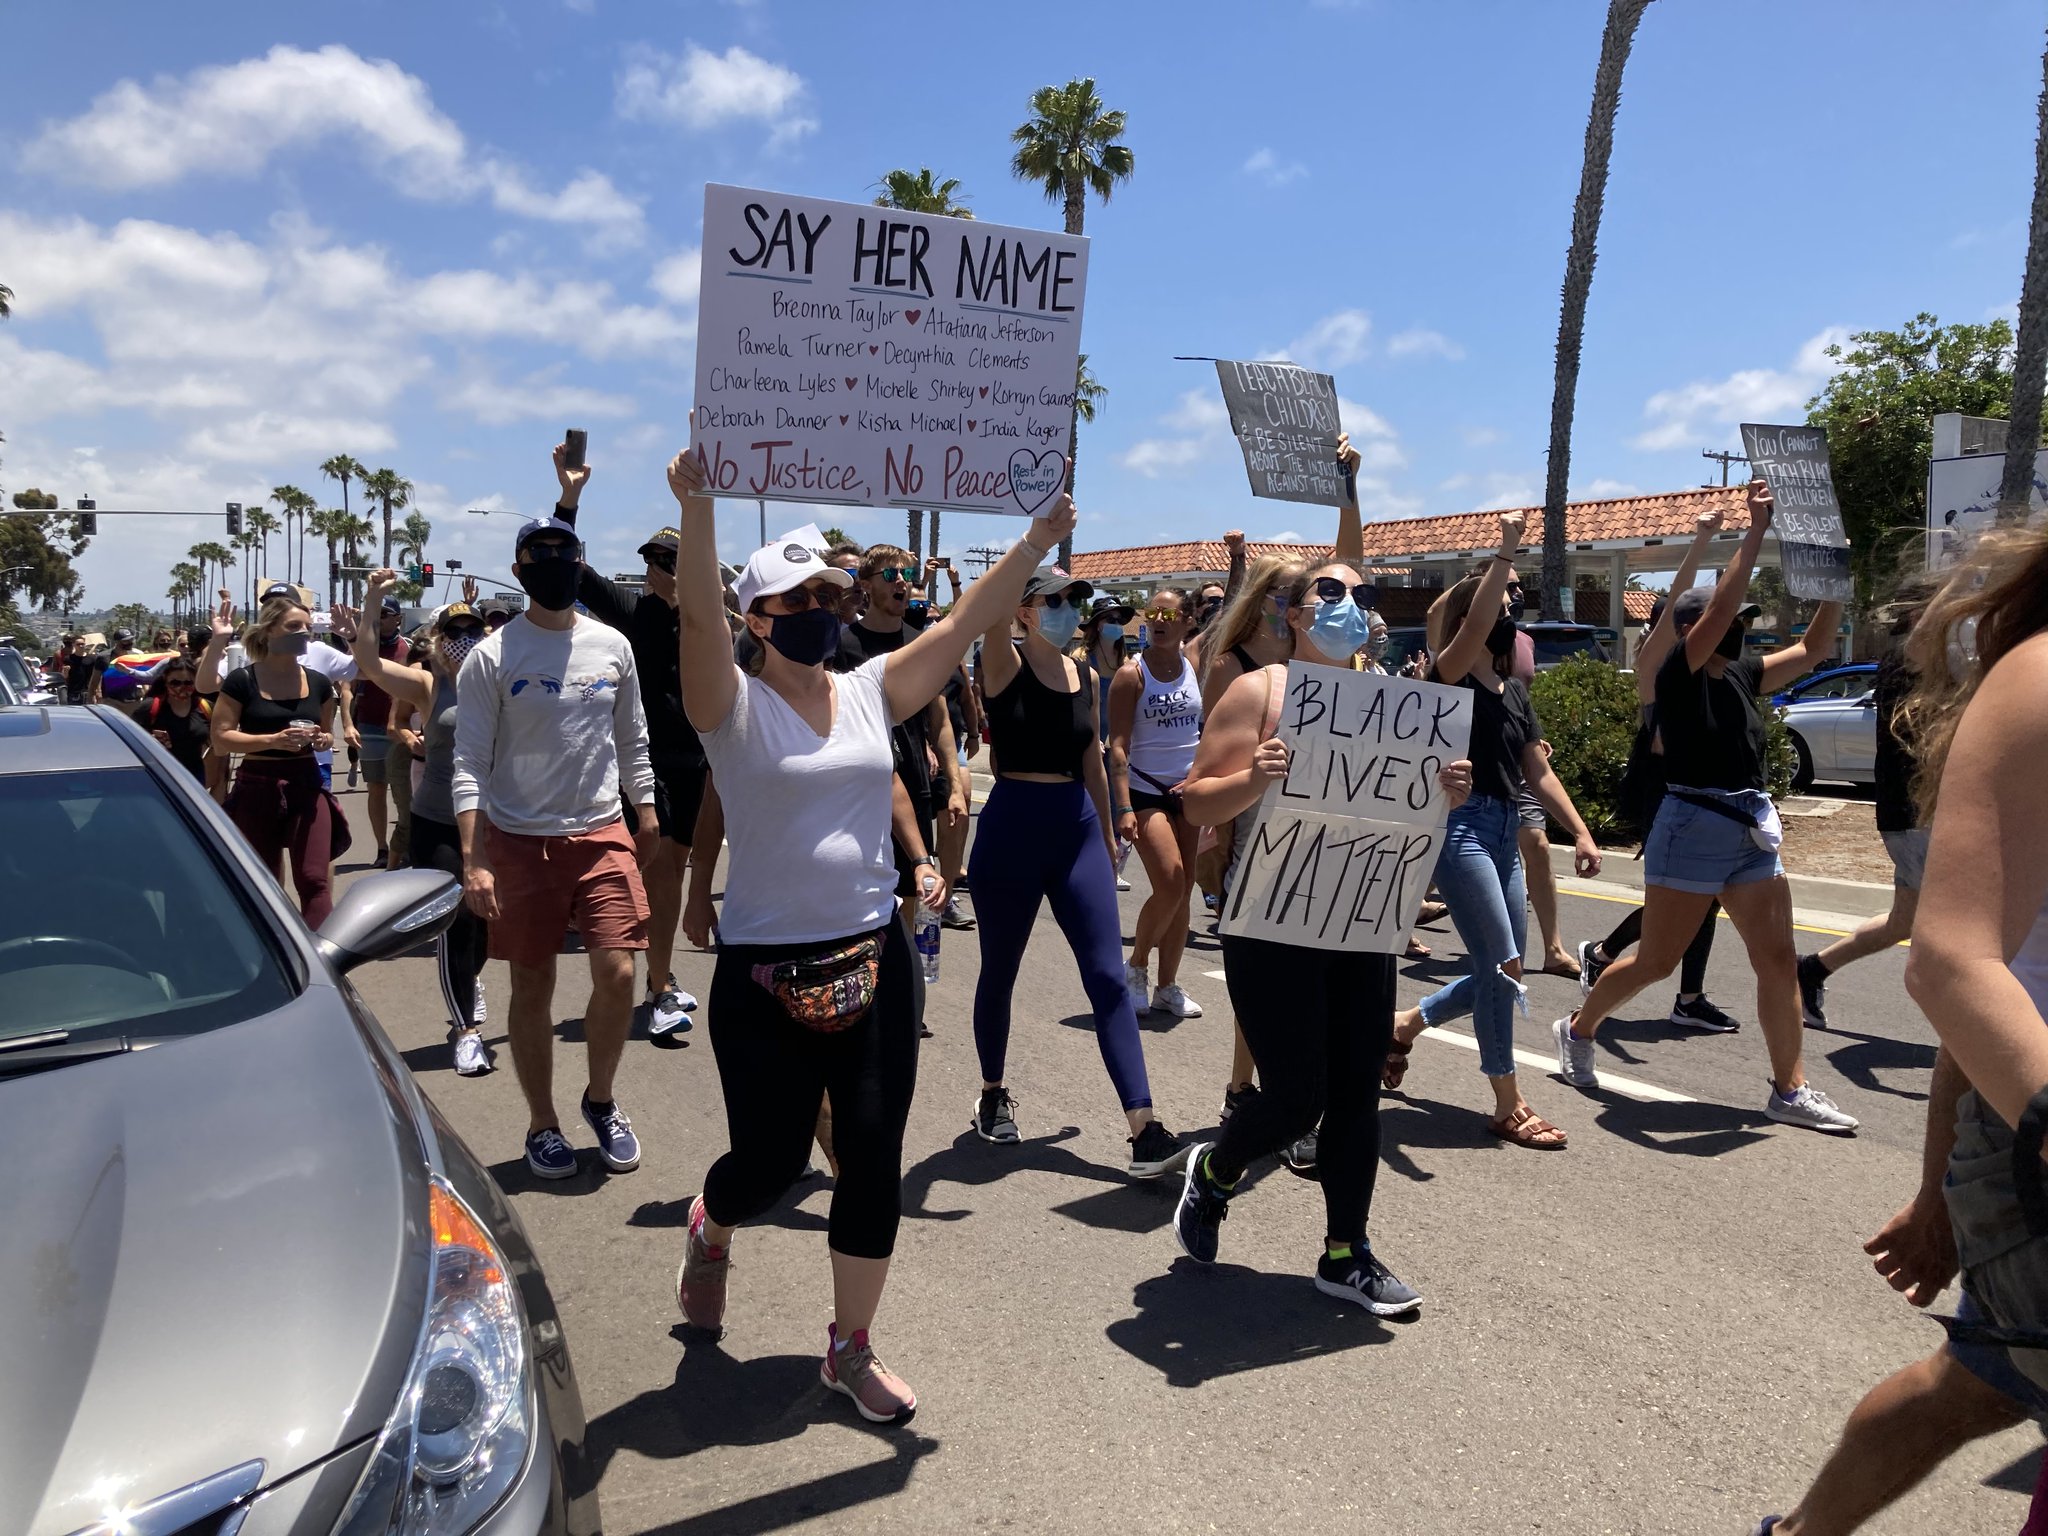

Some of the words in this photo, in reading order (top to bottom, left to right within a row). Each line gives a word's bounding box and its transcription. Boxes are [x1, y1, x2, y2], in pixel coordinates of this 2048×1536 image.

[728, 203, 832, 275] SAY
[853, 217, 934, 297] HER
[955, 235, 1077, 312] NAME
[773, 290, 843, 320] Breonna
[845, 299, 900, 333] Taylor
[923, 306, 988, 342] Atatiana
[991, 314, 1055, 343] Jefferson
[738, 326, 795, 357] Pamela
[801, 333, 868, 357] Turner
[884, 340, 956, 374] Decynthia
[969, 347, 1030, 370] Clements
[710, 367, 792, 393] Charleena
[798, 373, 837, 400] Lyles
[866, 374, 920, 399] Michelle
[928, 378, 976, 409] Shirley
[992, 380, 1035, 416] Korryn
[1039, 385, 1076, 408] Gaines
[1232, 361, 1290, 393] TEACH
[1286, 367, 1336, 401] BLACK
[699, 405, 764, 430] Deborah
[776, 407, 833, 430] Danner
[858, 410, 902, 432] Kisha
[911, 412, 962, 435] Michael
[979, 418, 1020, 438] India
[1026, 416, 1066, 445] Kager
[1264, 392, 1338, 432] CHILDREN
[1255, 428, 1276, 451] BE
[1277, 432, 1324, 454] SILENT
[1746, 426, 1777, 458] YOU
[1780, 429, 1819, 456] CANNOT
[698, 440, 739, 490] No
[750, 440, 872, 498] Justice,
[884, 444, 923, 495] No
[944, 445, 1012, 499] Peace
[1013, 462, 1037, 478] Rest
[1043, 465, 1055, 478] in
[1249, 449, 1280, 472] ABOUT
[1284, 453, 1304, 472] THE
[1308, 458, 1352, 479] INJUSTICES
[1752, 459, 1801, 488] TEACH
[1015, 479, 1055, 493] Power
[1267, 472, 1308, 494] AGAINST
[1310, 476, 1337, 496] THEM
[1777, 486, 1833, 507] CHILDREN
[1783, 513, 1803, 532] BE
[1803, 513, 1841, 532] SILENT
[1810, 532, 1833, 550] THE
[1791, 549, 1836, 570] INJUSTICES
[1791, 573, 1827, 594] AGAINST
[1144, 702, 1188, 719] LIVES
[1148, 690, 1191, 706] BLACK
[1289, 674, 1460, 748] BLACK
[1157, 714, 1197, 728] MATTER
[1282, 749, 1441, 811] LIVES
[1230, 819, 1432, 943] MATTER
